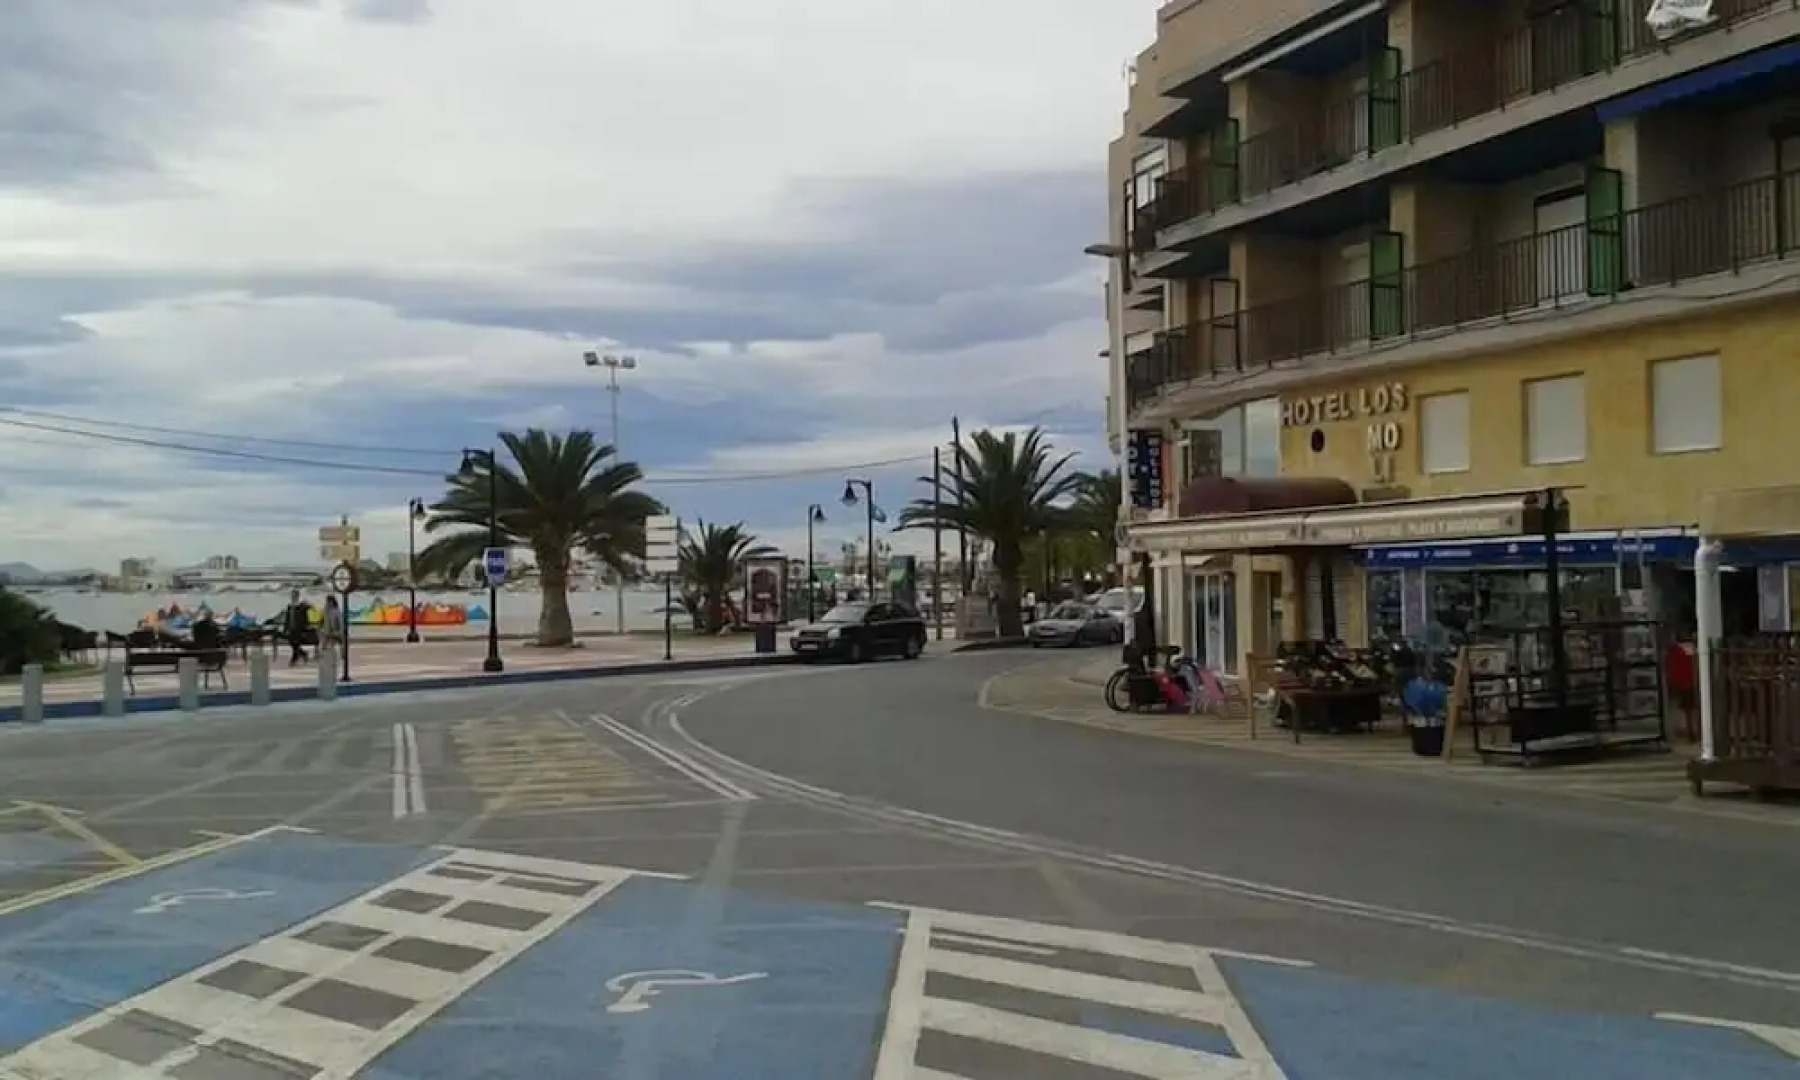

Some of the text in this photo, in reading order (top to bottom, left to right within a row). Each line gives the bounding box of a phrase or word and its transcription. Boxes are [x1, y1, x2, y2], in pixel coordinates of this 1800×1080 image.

[1282, 383, 1406, 425] HOTEL LOS
[1367, 423, 1399, 451] MO
